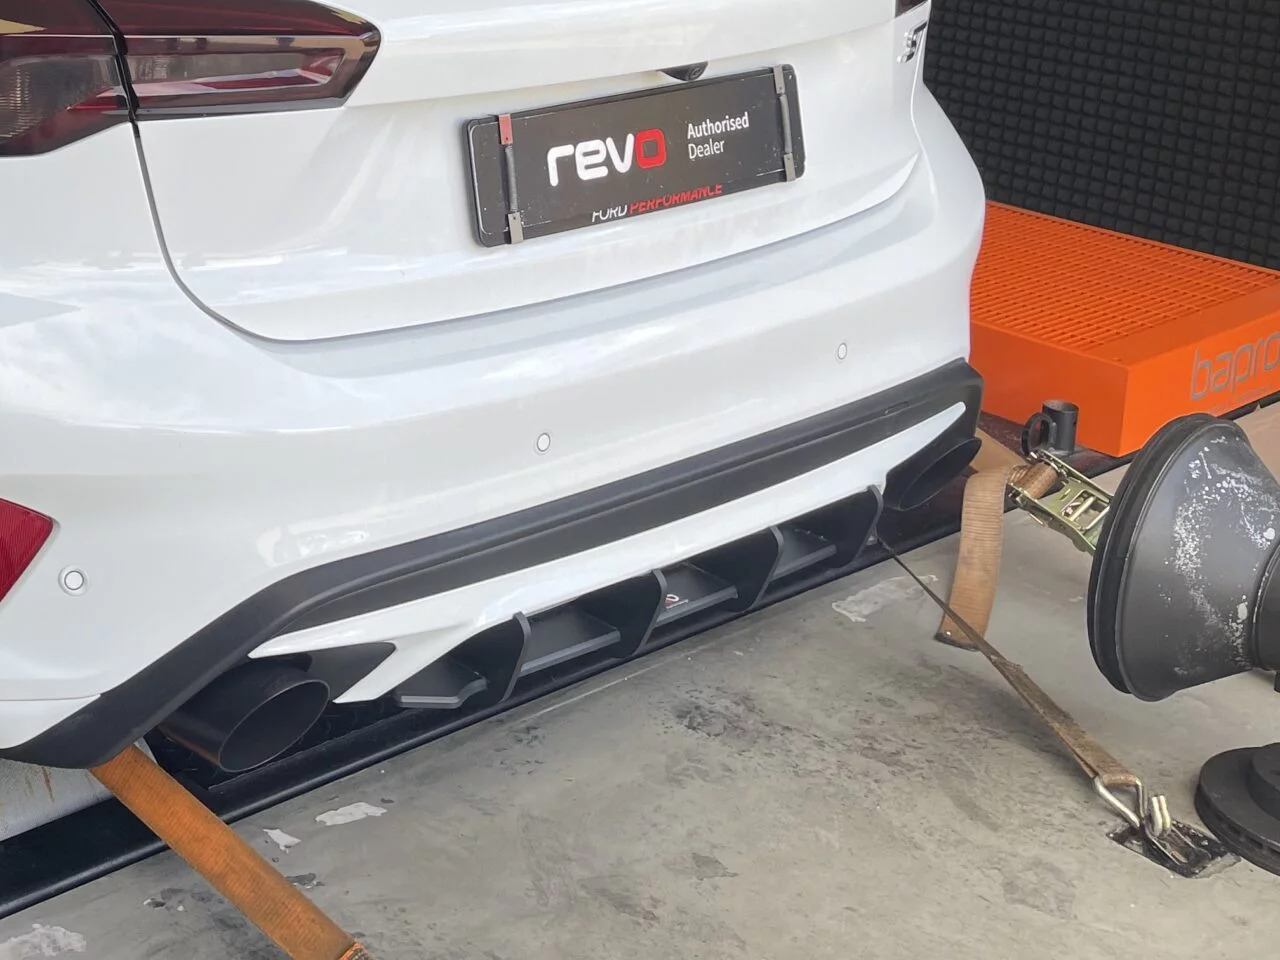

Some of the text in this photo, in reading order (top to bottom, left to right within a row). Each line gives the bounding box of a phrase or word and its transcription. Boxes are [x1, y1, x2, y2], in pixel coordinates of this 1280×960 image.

[547, 111, 749, 187] revo Authorised
[688, 139, 725, 160] Dealer
[1191, 331, 1280, 401] bapro
